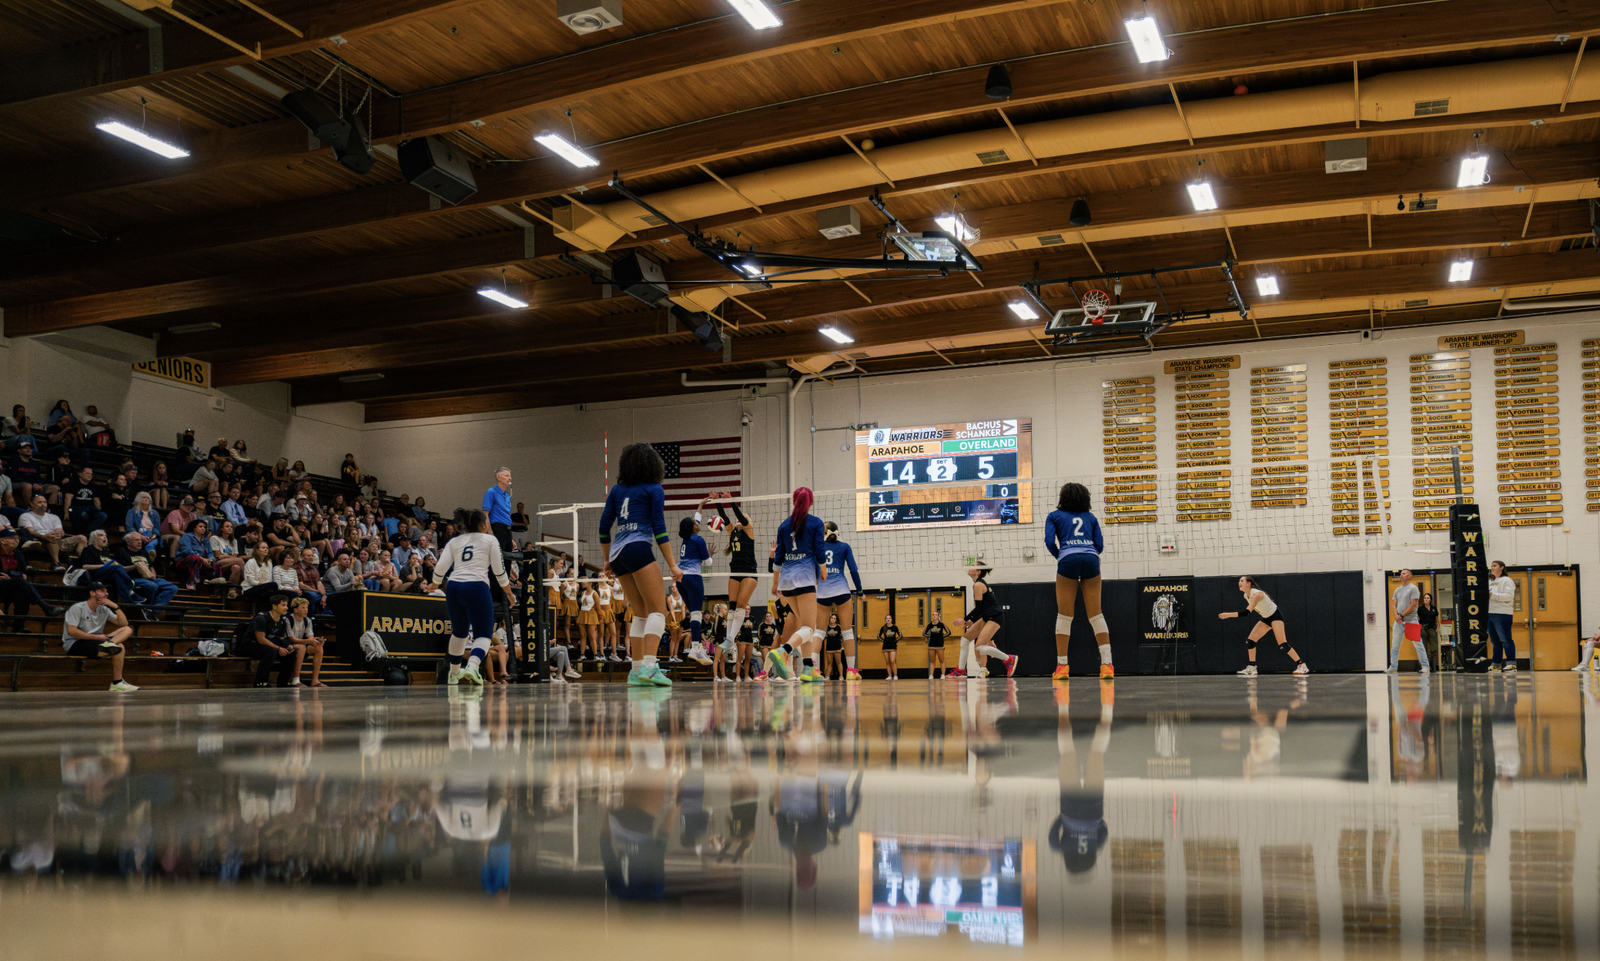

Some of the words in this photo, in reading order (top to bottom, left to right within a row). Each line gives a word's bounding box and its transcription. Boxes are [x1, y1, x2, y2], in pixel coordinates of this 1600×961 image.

[1444, 335, 1479, 345] ARAPAHOE
[1482, 332, 1517, 341] WARRIORS
[1450, 341, 1470, 349] STATE
[1472, 338, 1513, 347] RUNNER-UP
[1170, 360, 1201, 368] ARAPAHOE
[1202, 356, 1234, 365] WARRIORS
[1194, 362, 1230, 371] CHAMPIONS
[966, 421, 1001, 431] BACHUS
[891, 430, 943, 442] WARRIORS
[956, 430, 1001, 442] SCHANKER
[959, 438, 1016, 450] OVERLAND
[870, 445, 924, 457] ARAPAHOE
[882, 461, 916, 486] 14
[938, 466, 947, 480] 2
[978, 456, 994, 480] 5
[1000, 486, 1009, 498] 0
[878, 494, 886, 505] 1
[620, 497, 630, 520] 4
[876, 511, 895, 520] JFR
[1072, 516, 1084, 536] 2
[732, 542, 740, 552] 13
[462, 545, 474, 562] 6
[825, 550, 834, 566] 3
[1143, 584, 1188, 592] ARAPAHOE
[1462, 532, 1480, 644] WARRIORS
[526, 573, 536, 662] ARAPAHOE
[370, 616, 452, 634] ARAPAHOE
